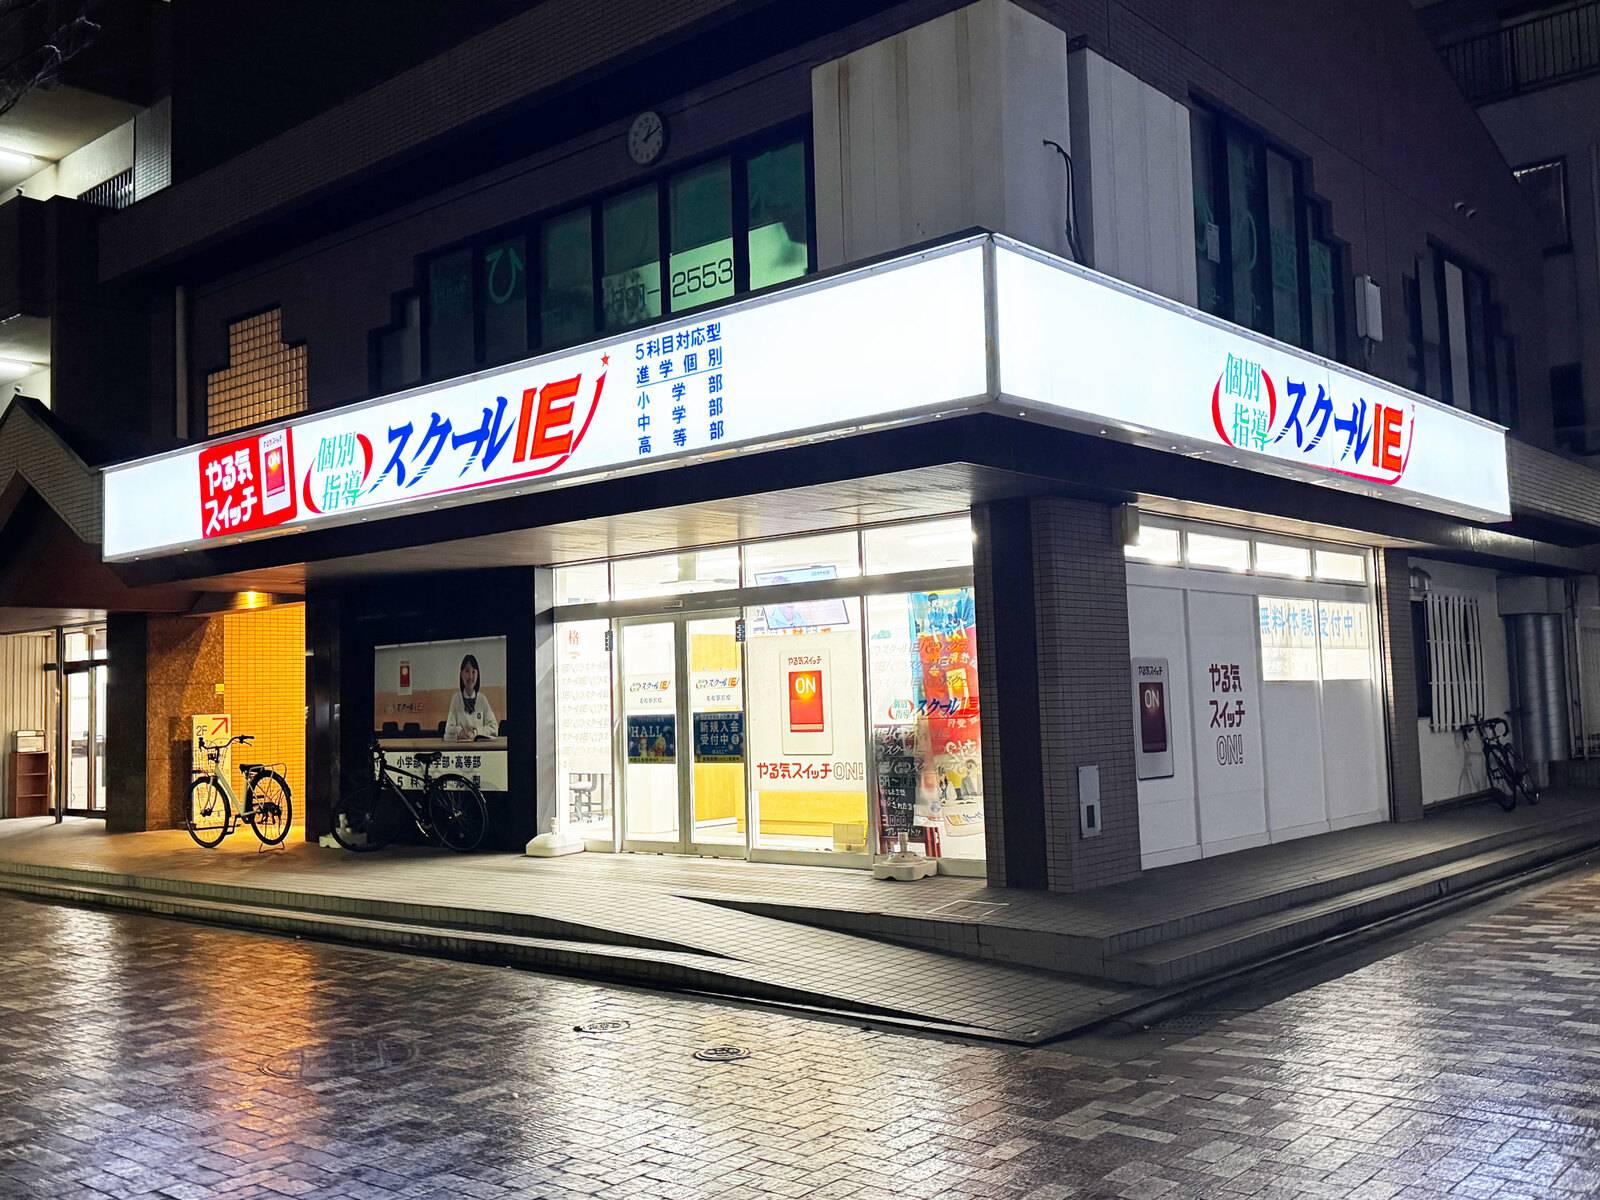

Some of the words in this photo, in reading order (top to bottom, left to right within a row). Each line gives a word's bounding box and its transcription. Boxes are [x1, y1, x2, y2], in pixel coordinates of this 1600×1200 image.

[635, 322, 721, 361] 5科目対応型
[636, 346, 723, 384] 進学個別
[1225, 352, 1261, 402] 個別
[1232, 402, 1274, 451] 指導
[317, 430, 357, 473] 個別
[205, 448, 254, 496] やる気
[322, 470, 366, 511] 指導
[205, 486, 257, 537] スイッチ
[795, 676, 816, 695] ON
[1208, 663, 1242, 693] やる気
[1144, 689, 1160, 708] ON
[1209, 700, 1245, 728] スイッチ
[196, 725, 208, 737] 2F
[1216, 734, 1244, 765] ON!
